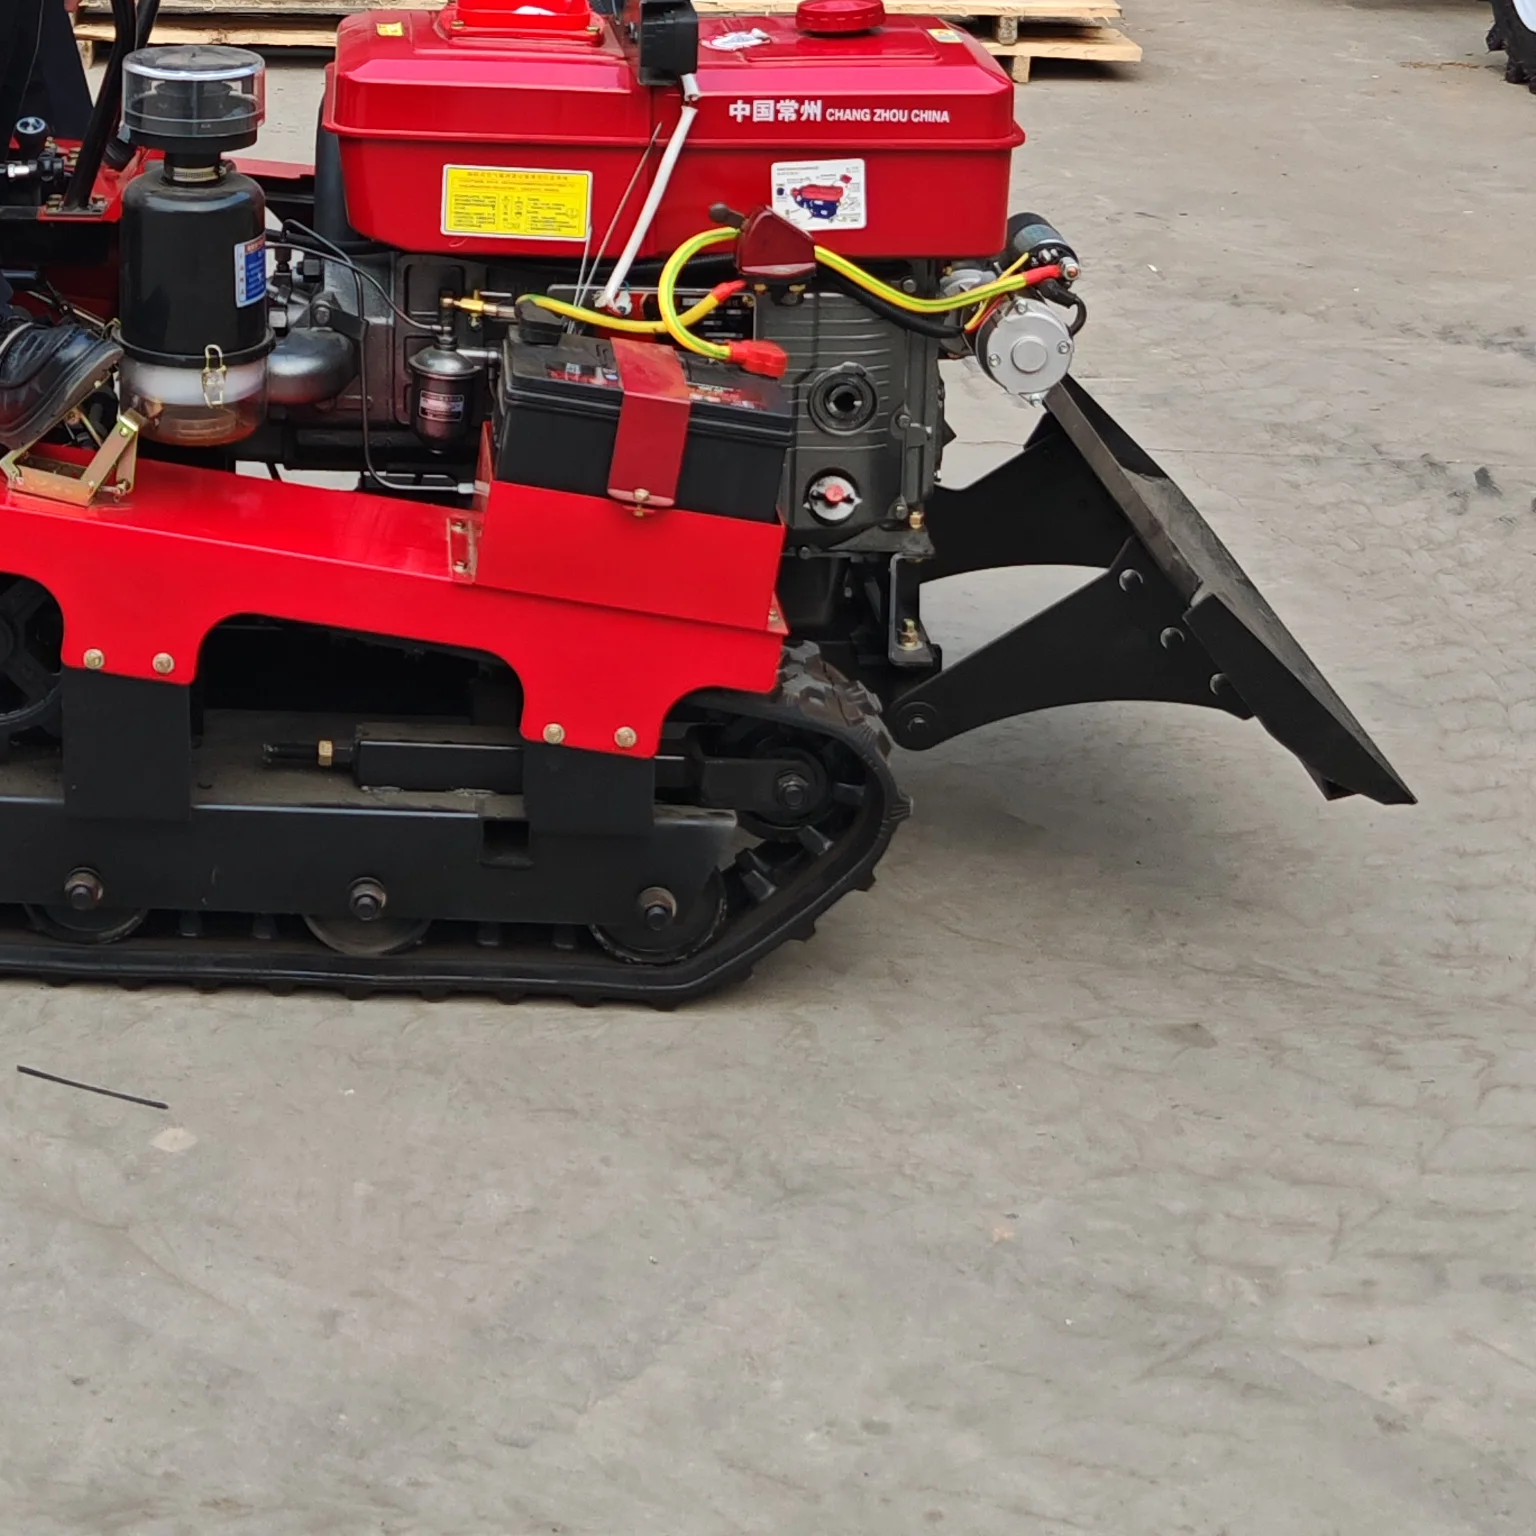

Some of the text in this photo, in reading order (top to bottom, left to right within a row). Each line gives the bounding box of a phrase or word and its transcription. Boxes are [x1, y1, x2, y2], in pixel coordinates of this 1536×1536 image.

[729, 99, 950, 123] 中国常州 CHANG ZHOU CHINA
